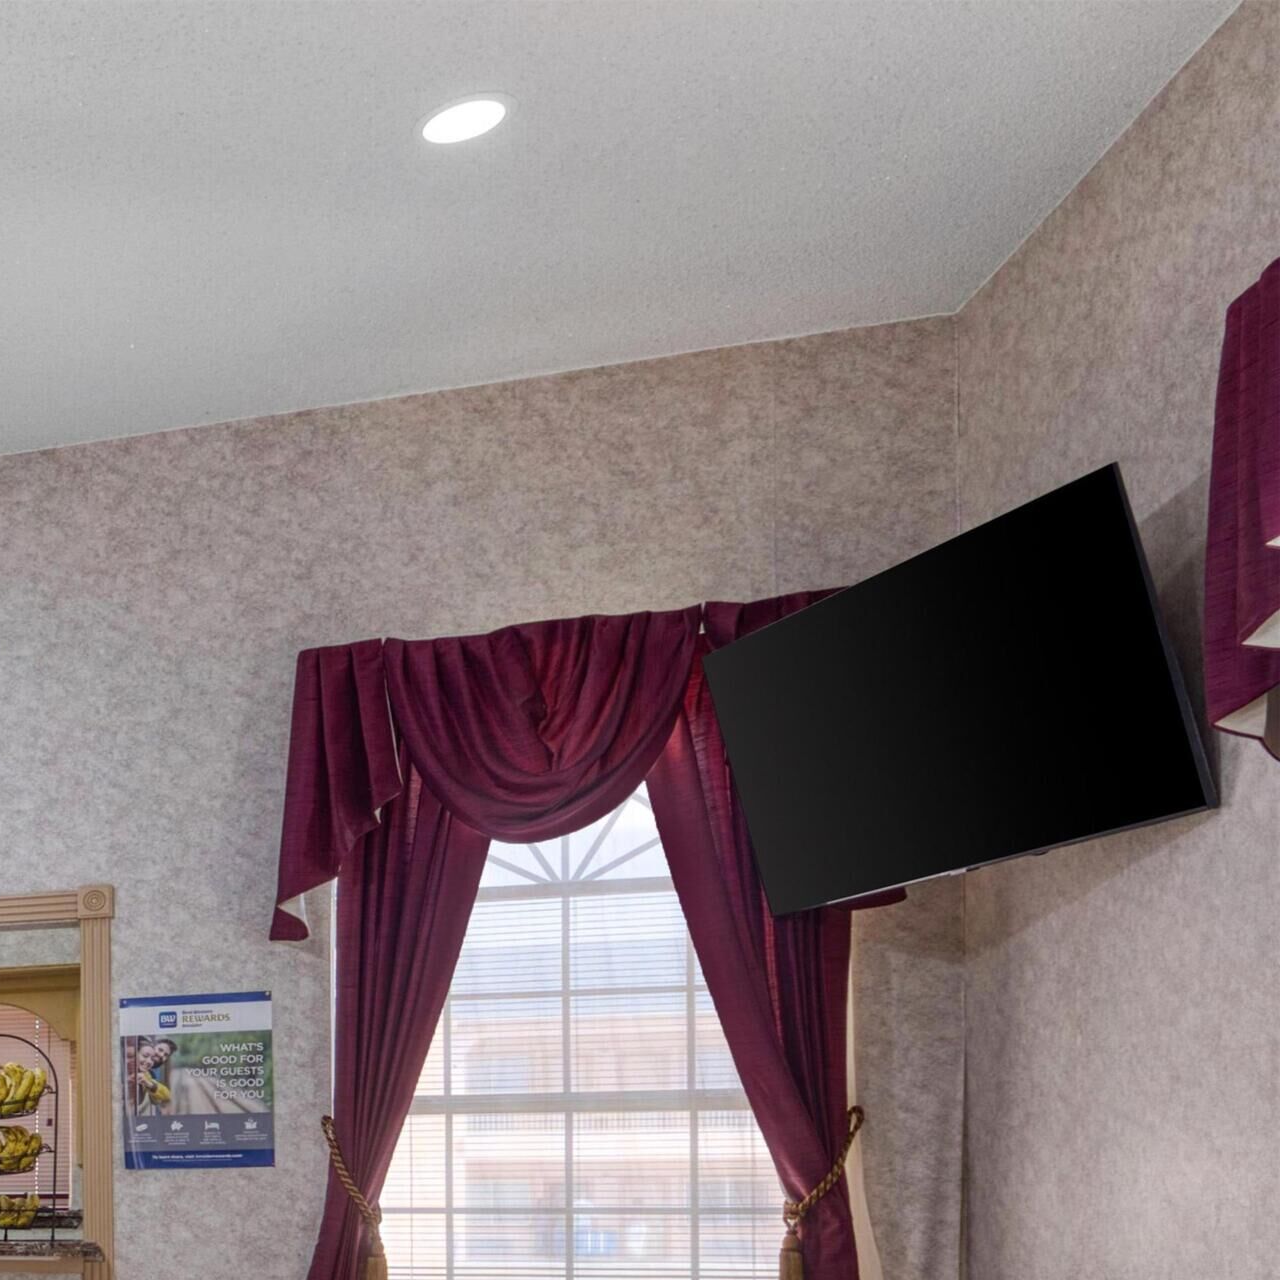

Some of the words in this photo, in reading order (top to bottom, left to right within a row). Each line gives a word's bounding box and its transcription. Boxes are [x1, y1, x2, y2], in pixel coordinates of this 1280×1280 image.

[160, 1014, 176, 1023] BW
[182, 1013, 231, 1023] REWARDS
[220, 1042, 264, 1052] WHAT'S
[202, 1055, 237, 1065] GOOD
[239, 1055, 264, 1063] FOR
[186, 1068, 217, 1077] YOUR
[220, 1066, 265, 1076] GUESTS
[216, 1080, 227, 1088] IS
[229, 1078, 265, 1088] GOOD
[214, 1091, 237, 1099] FOR
[241, 1090, 265, 1099] YOU
